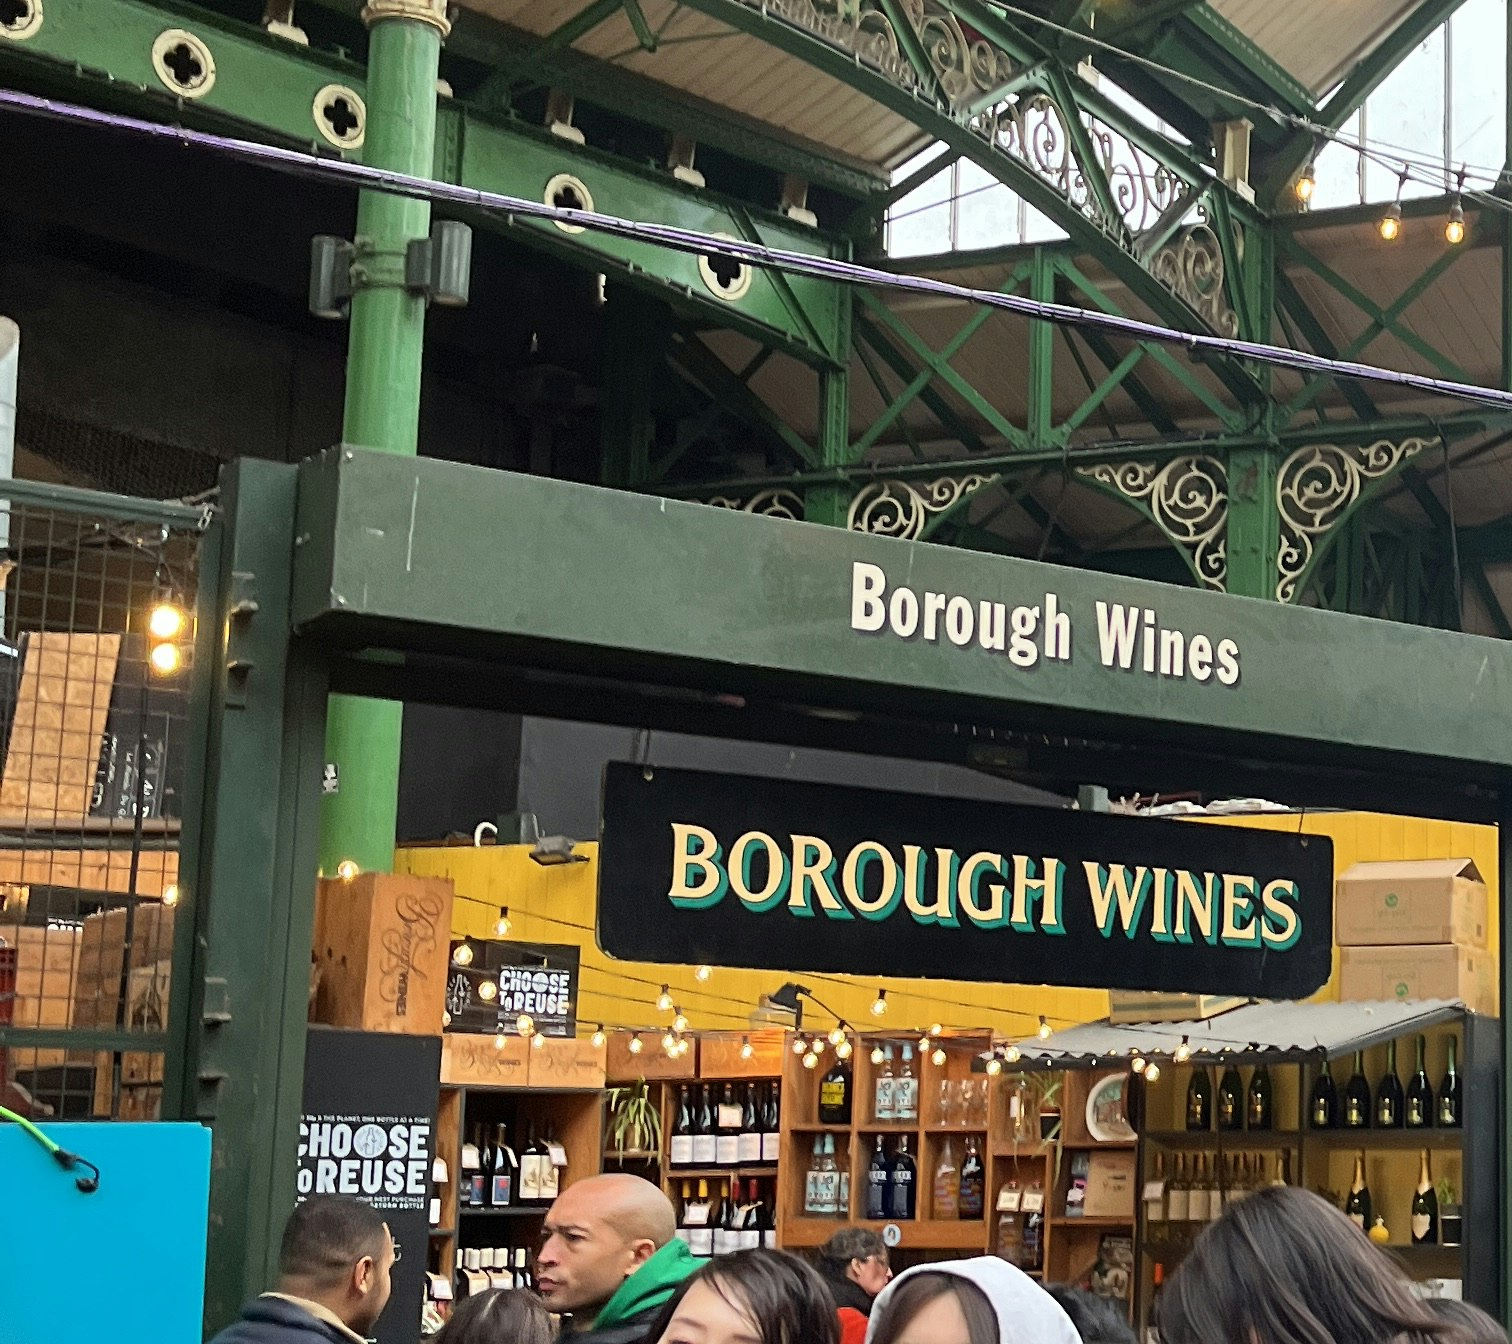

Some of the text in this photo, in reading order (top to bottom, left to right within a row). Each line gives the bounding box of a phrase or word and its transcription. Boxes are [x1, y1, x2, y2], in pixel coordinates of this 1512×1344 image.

[851, 562, 1240, 686] Borough Wines
[668, 822, 1302, 952] BOROUGH WINES
[499, 969, 570, 995] CHOOSE
[513, 991, 569, 1015] REUSE
[315, 1159, 428, 1194] REUSE
